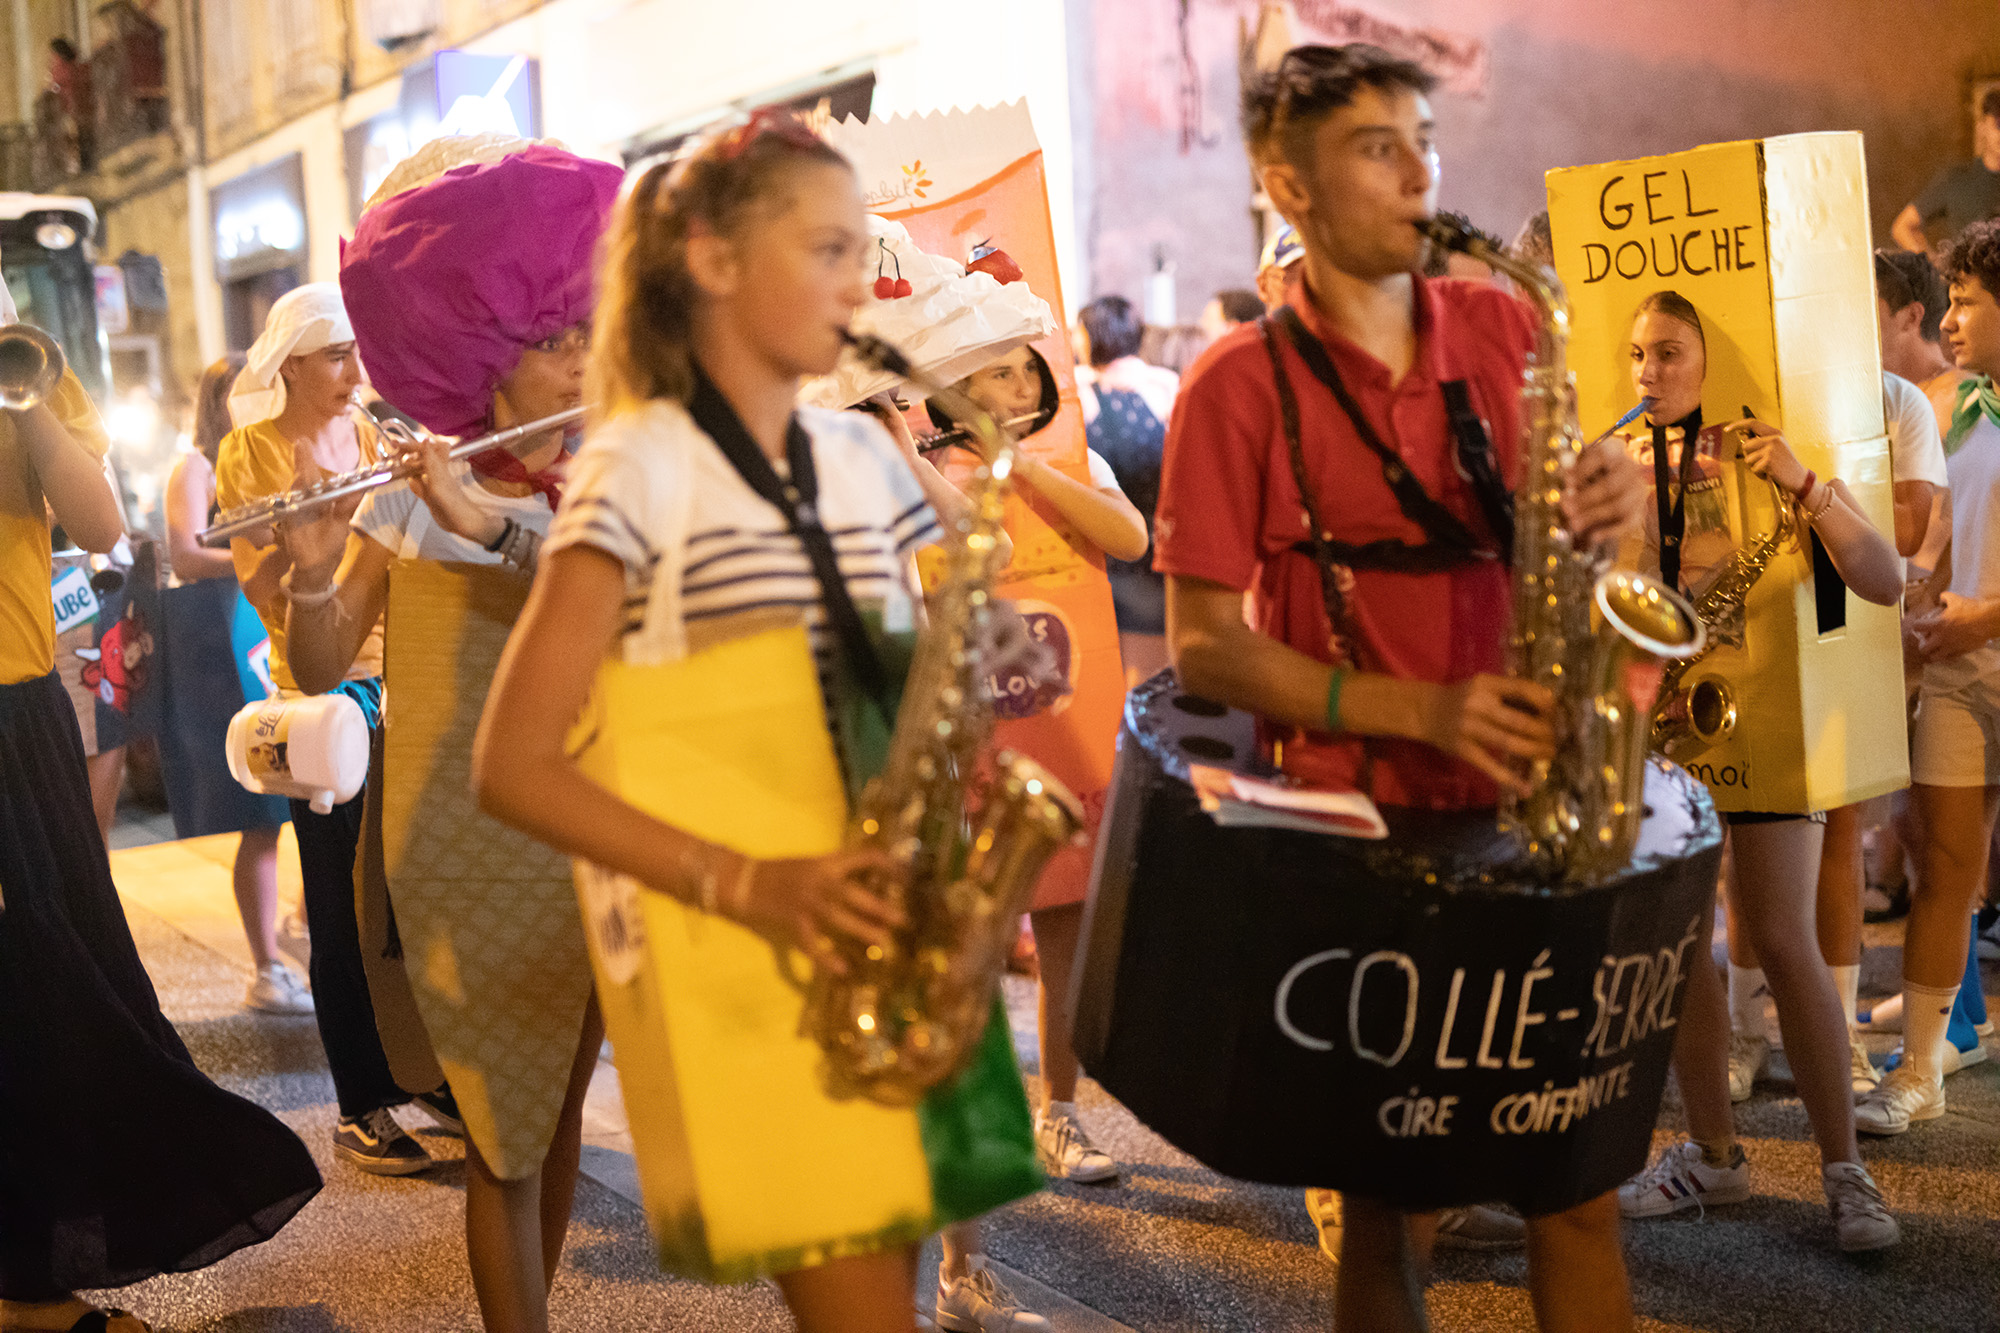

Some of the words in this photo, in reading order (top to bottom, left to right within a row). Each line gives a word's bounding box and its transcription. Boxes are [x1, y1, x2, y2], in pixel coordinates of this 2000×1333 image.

[1600, 169, 1719, 231] GEL
[1581, 226, 1756, 284] DOUCHE
[1687, 477, 1720, 492] NEW!
